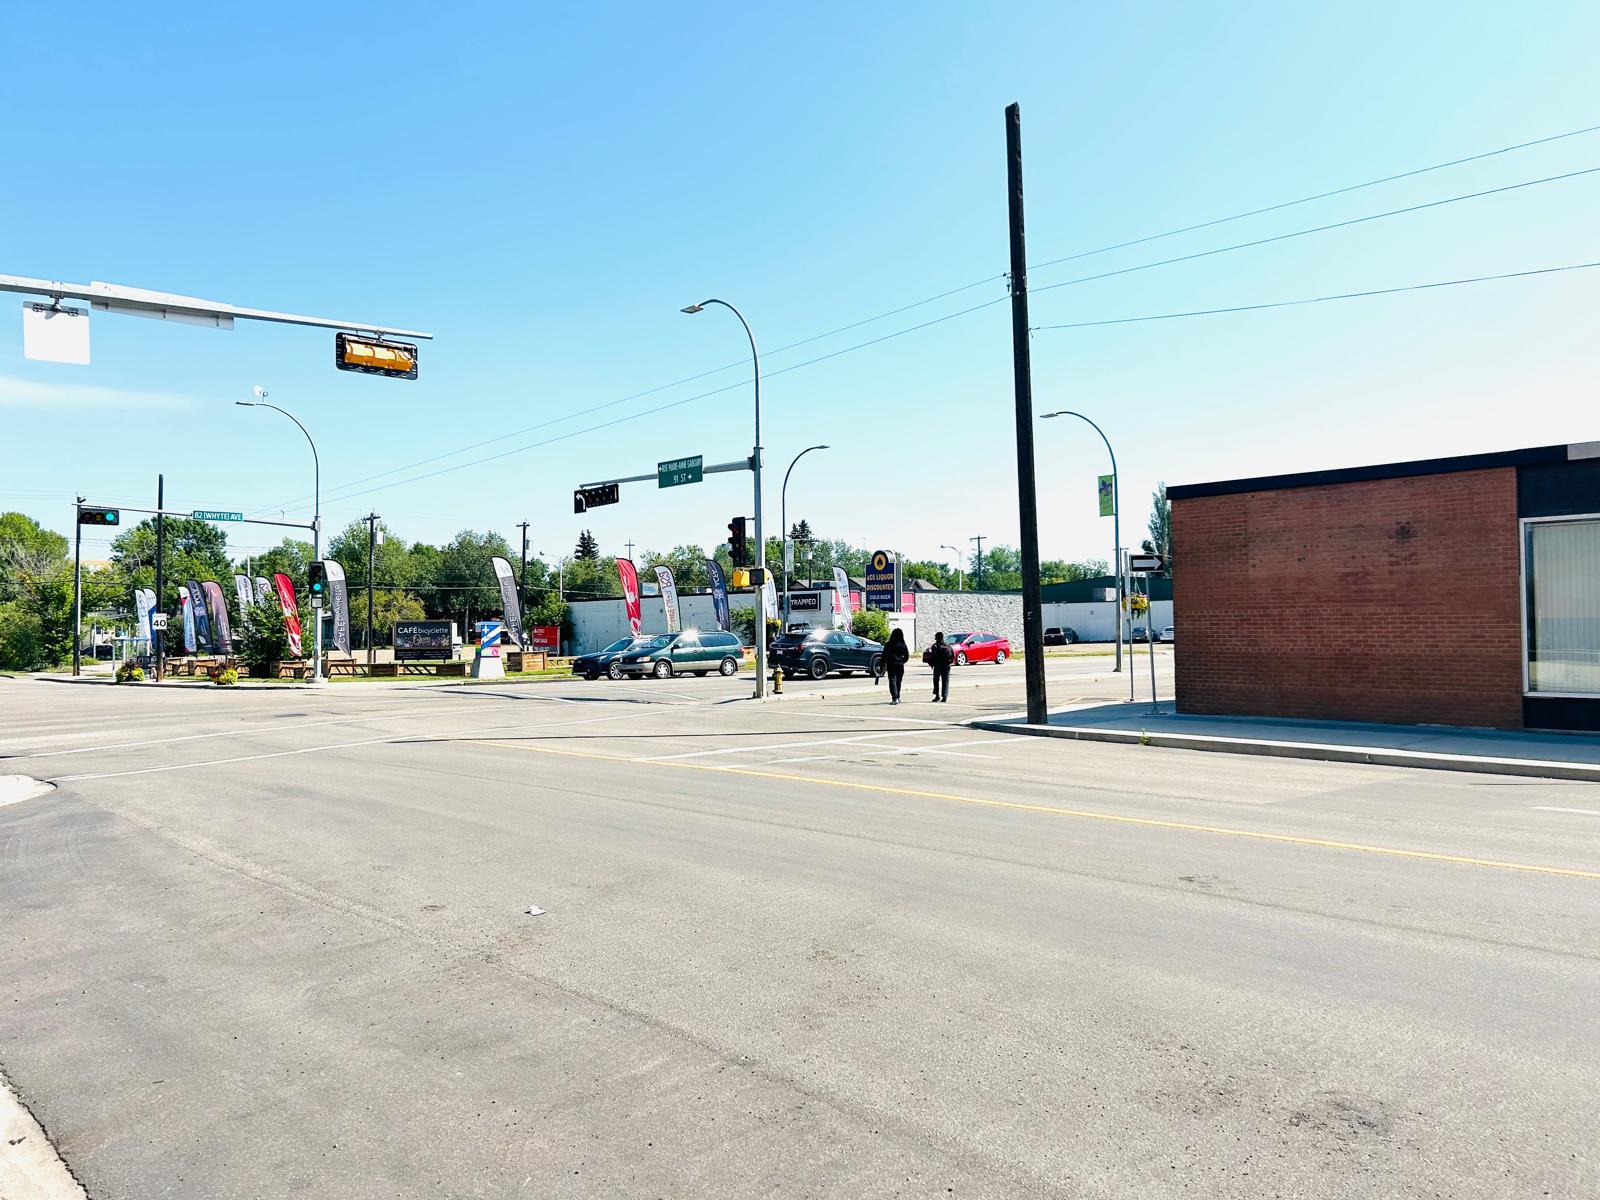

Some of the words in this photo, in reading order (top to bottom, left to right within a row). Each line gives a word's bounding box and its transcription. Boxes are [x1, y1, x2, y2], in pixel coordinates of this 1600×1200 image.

[673, 474, 679, 484] 91
[680, 472, 687, 483] ST
[194, 511, 203, 519] 82
[876, 573, 894, 581] LIQUOR
[790, 598, 817, 606] TRAPPED
[153, 619, 166, 627] 40
